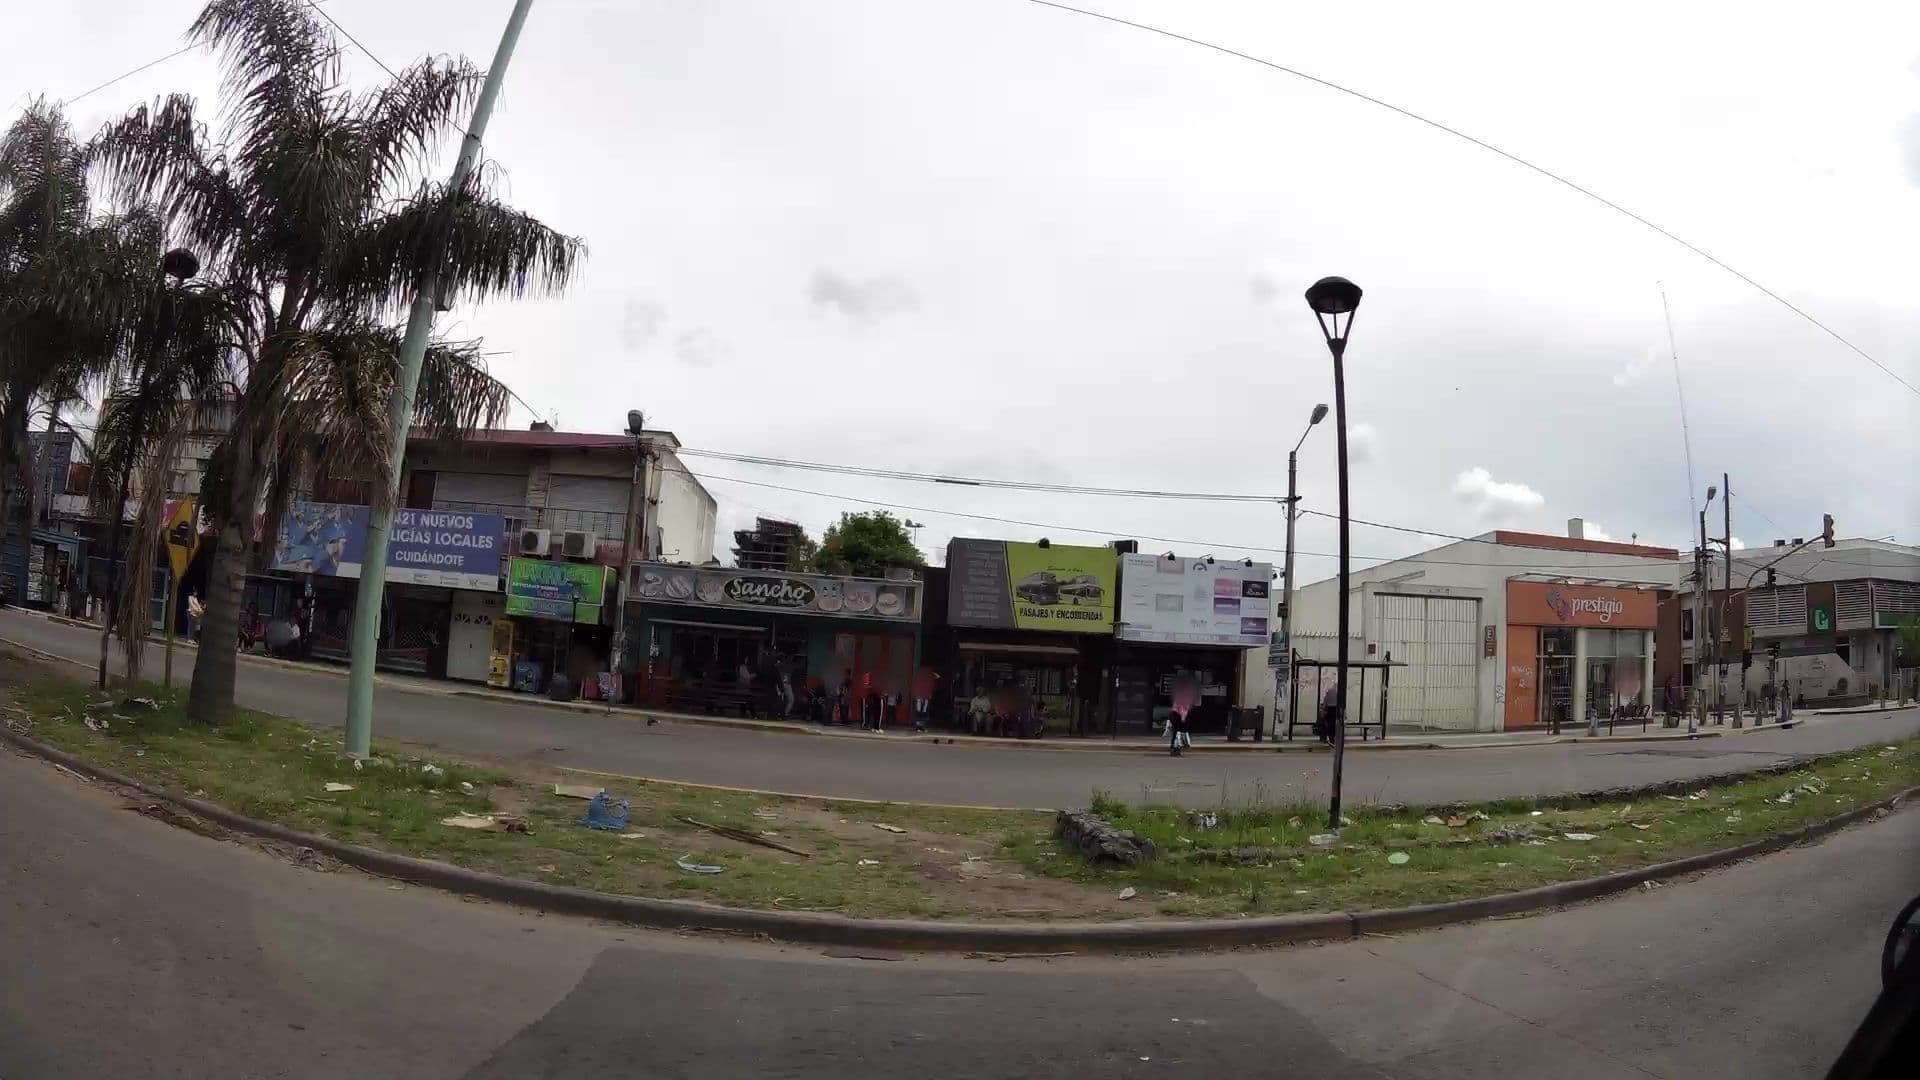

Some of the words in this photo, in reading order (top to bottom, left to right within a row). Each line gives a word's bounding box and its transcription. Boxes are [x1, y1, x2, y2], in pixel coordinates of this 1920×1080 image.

[420, 514, 473, 530] NUEVOS
[390, 527, 431, 545] LICÍAS
[435, 531, 494, 549] LOCALES
[395, 550, 464, 566] CUIDÁNDOTE
[731, 578, 810, 600] Sancho
[1019, 607, 1048, 618] PASAJES
[1051, 608, 1055, 618] Y
[1056, 610, 1104, 621] ENCOMIENDAS
[1570, 597, 1623, 623] prestigio
